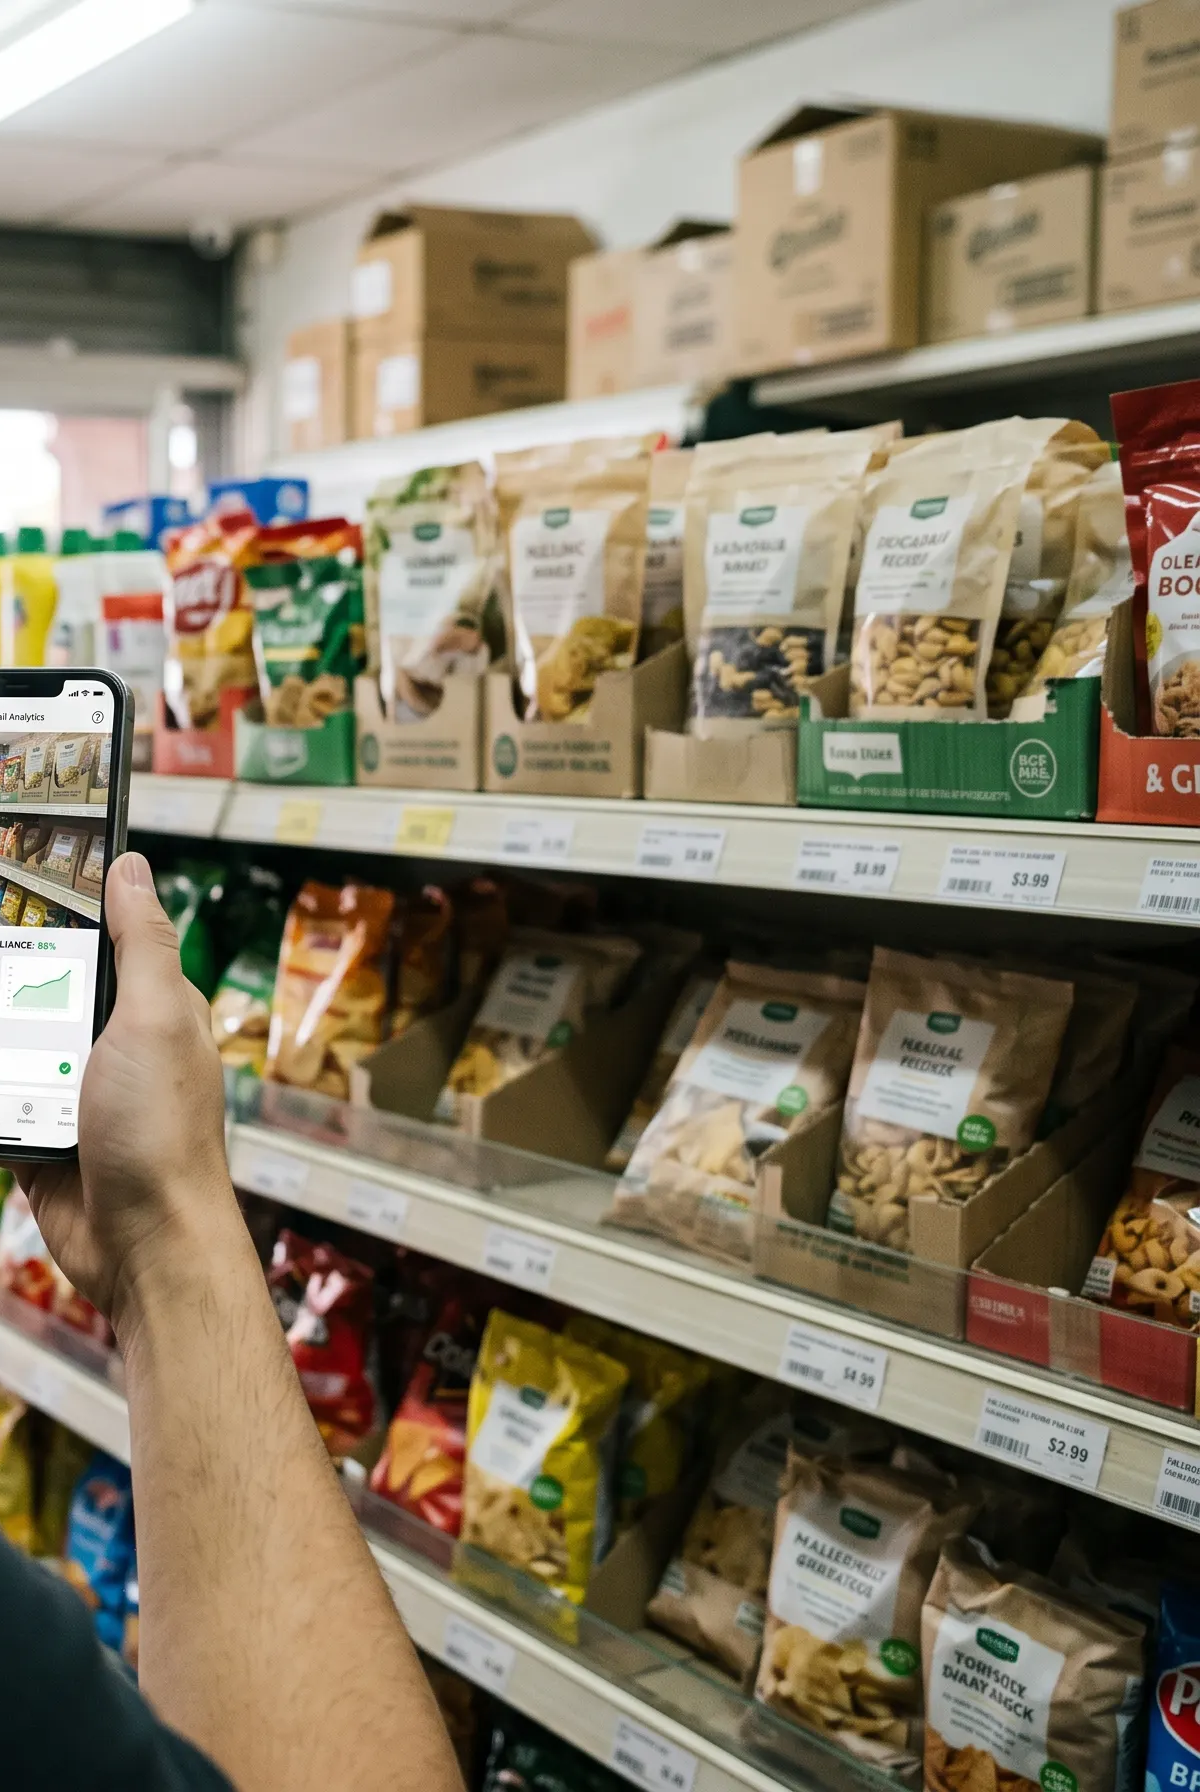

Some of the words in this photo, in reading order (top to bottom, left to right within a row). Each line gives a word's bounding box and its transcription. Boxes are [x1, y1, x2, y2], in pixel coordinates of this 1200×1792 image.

[1158, 575, 1200, 597] BO
[9, 712, 45, 723] Analytics
[1145, 763, 1165, 794] &
[1011, 871, 1050, 889] $3.99
[37, 941, 57, 951] 88%
[1047, 1437, 1089, 1463] $2.99
[1169, 1668, 1200, 1726] P
